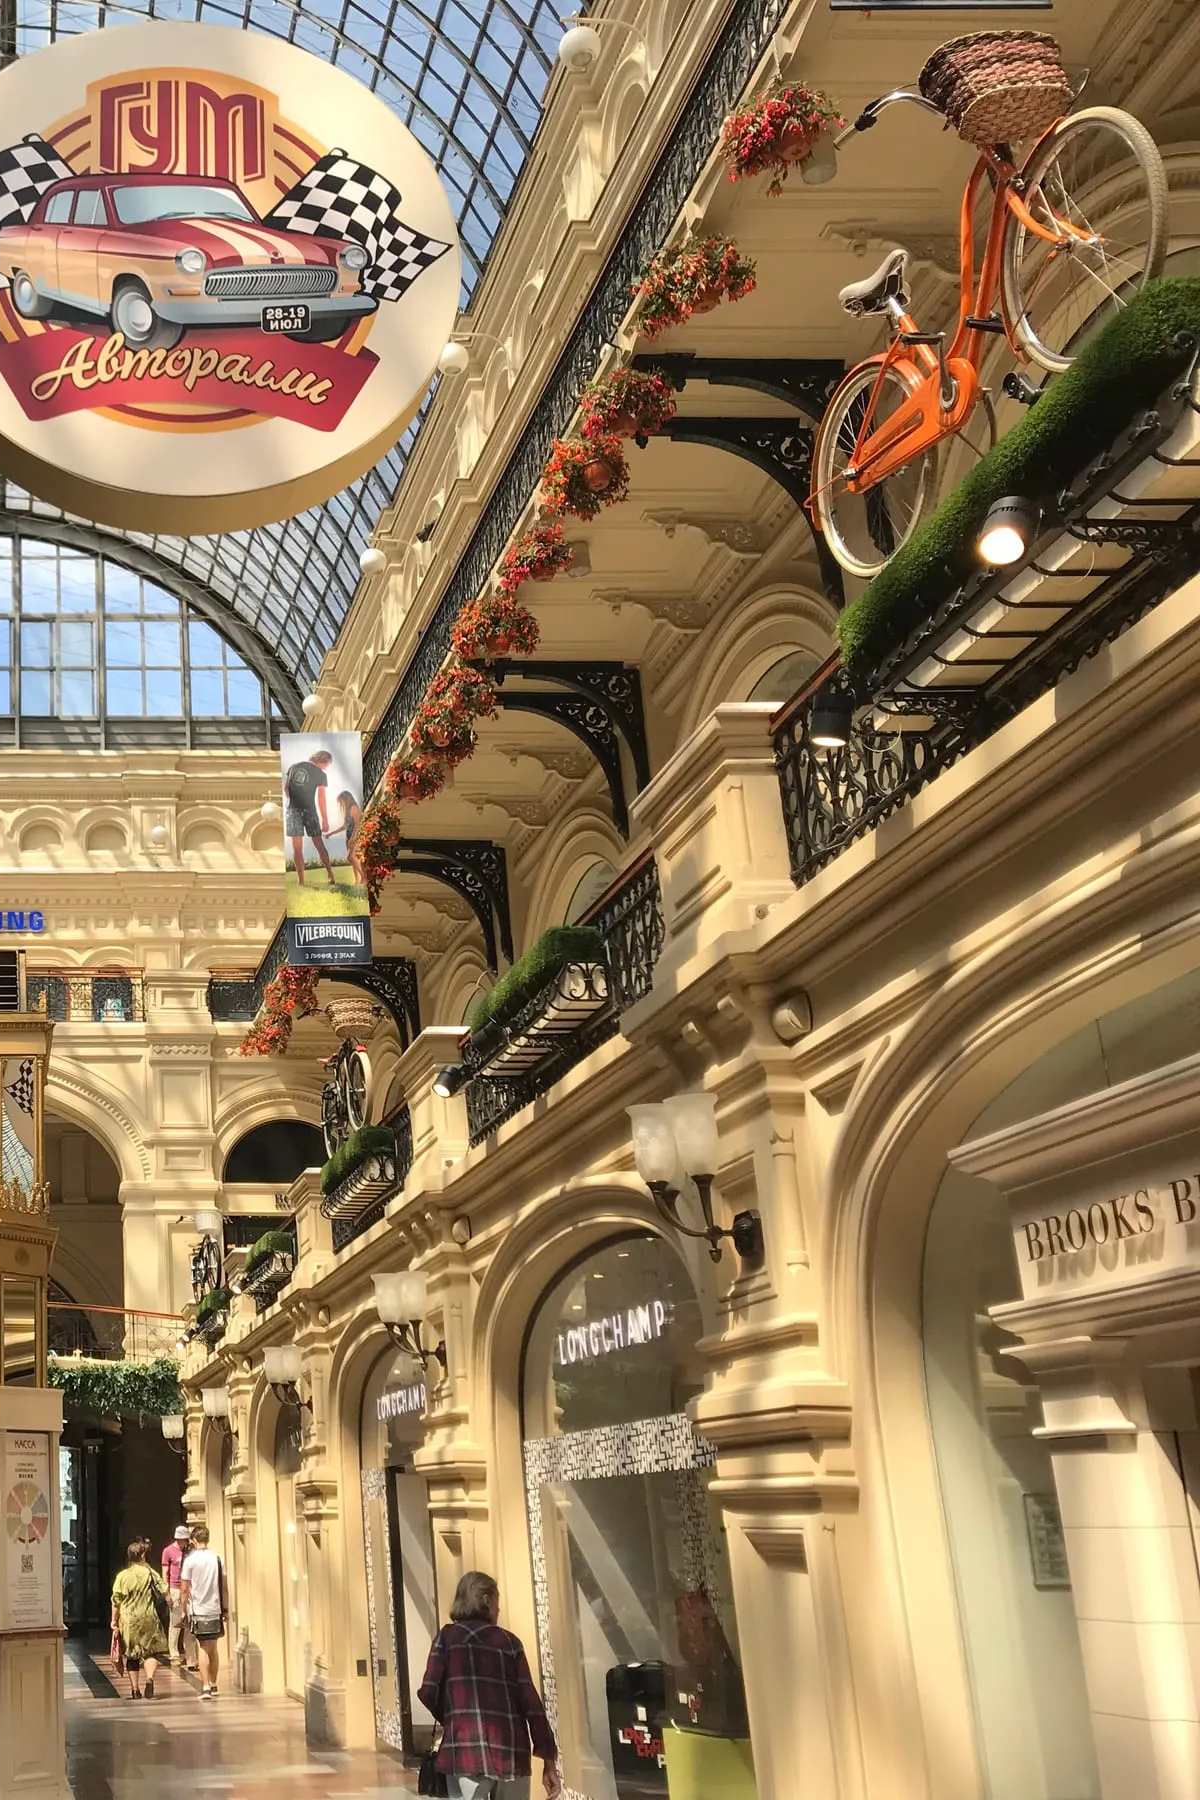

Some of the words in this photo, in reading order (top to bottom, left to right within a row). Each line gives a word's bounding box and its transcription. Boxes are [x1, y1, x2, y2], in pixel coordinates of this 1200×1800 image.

[100, 80, 267, 184] ГУМ
[266, 306, 306, 320] 28-19
[270, 318, 302, 331] ИЮЛ
[31, 333, 334, 404] Авторалли
[297, 925, 362, 945] VILEBREQUIN
[1022, 1188, 1155, 1262] BROOKS
[1168, 1173, 1200, 1224] B
[558, 1300, 665, 1366] LONGCHAMP
[376, 1383, 426, 1420] LONGCHAMP
[14, 1439, 37, 1449] КАССА
